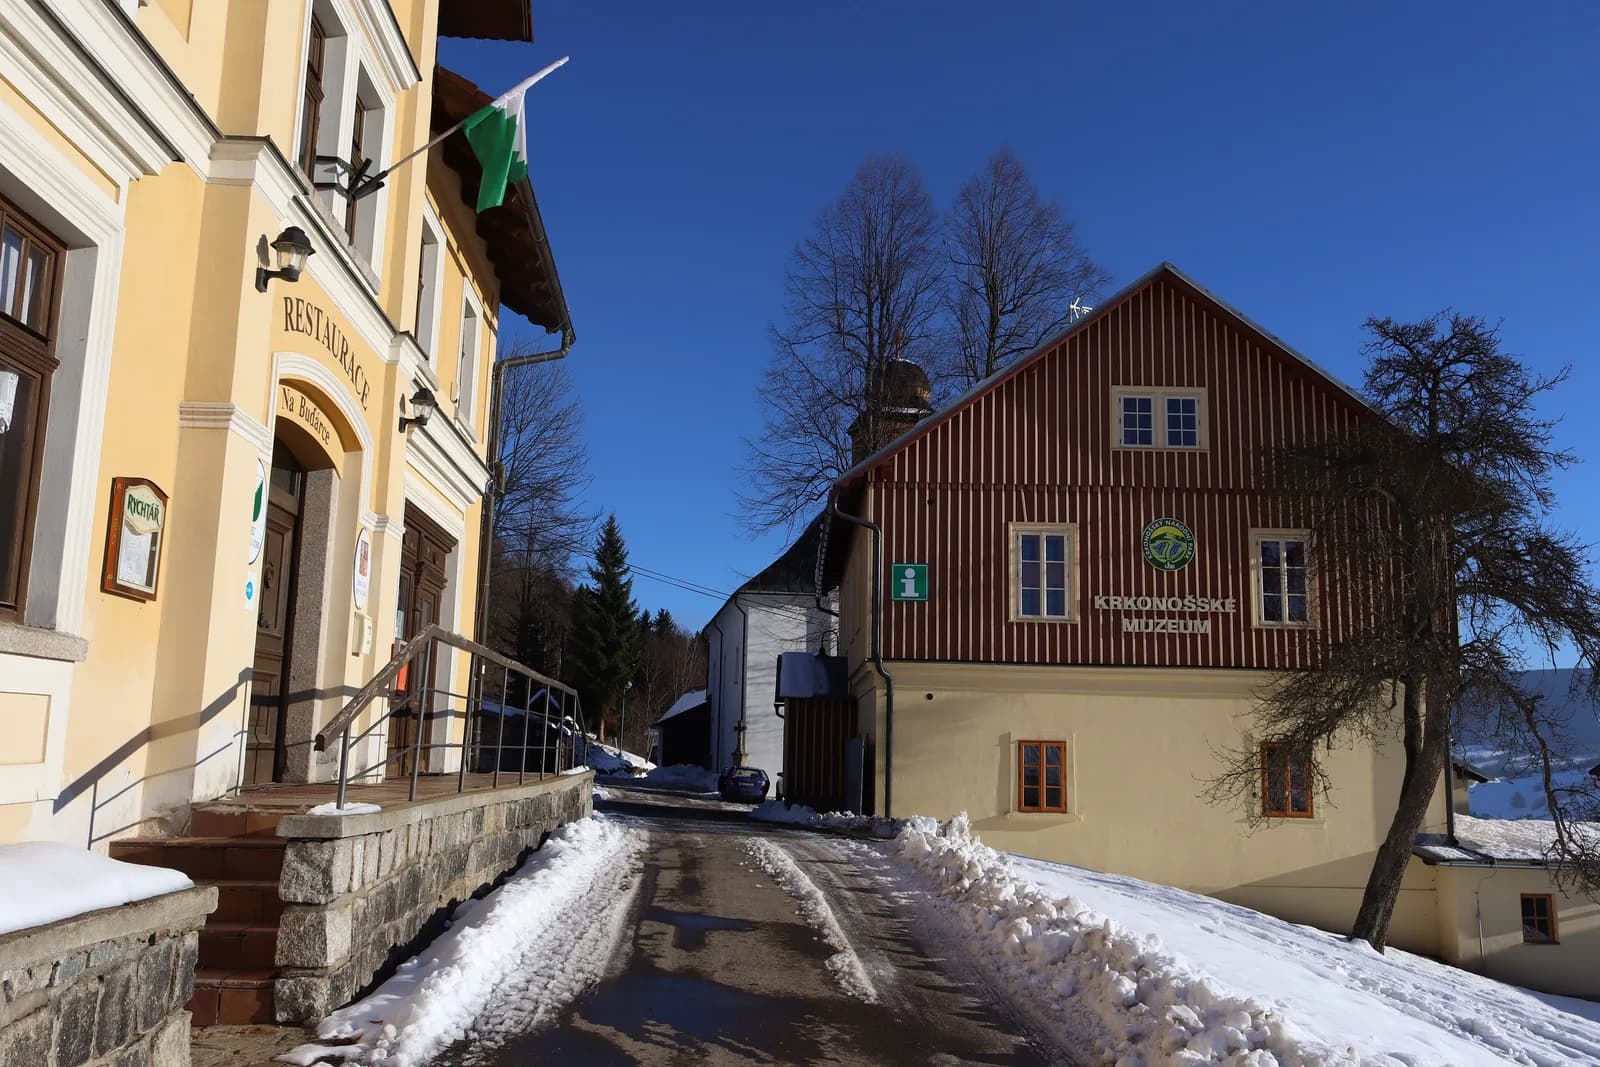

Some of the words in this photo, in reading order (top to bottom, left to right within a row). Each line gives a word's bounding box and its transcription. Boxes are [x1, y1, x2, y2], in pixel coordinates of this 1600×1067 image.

[283, 296, 370, 411] RESTAURACE
[281, 387, 294, 413] Na
[299, 395, 330, 445] Budárce
[127, 493, 161, 528] RYCHTÁŘ
[1094, 594, 1236, 613] KRKONOŠSKÉ
[1122, 618, 1209, 634] MUZEUM
